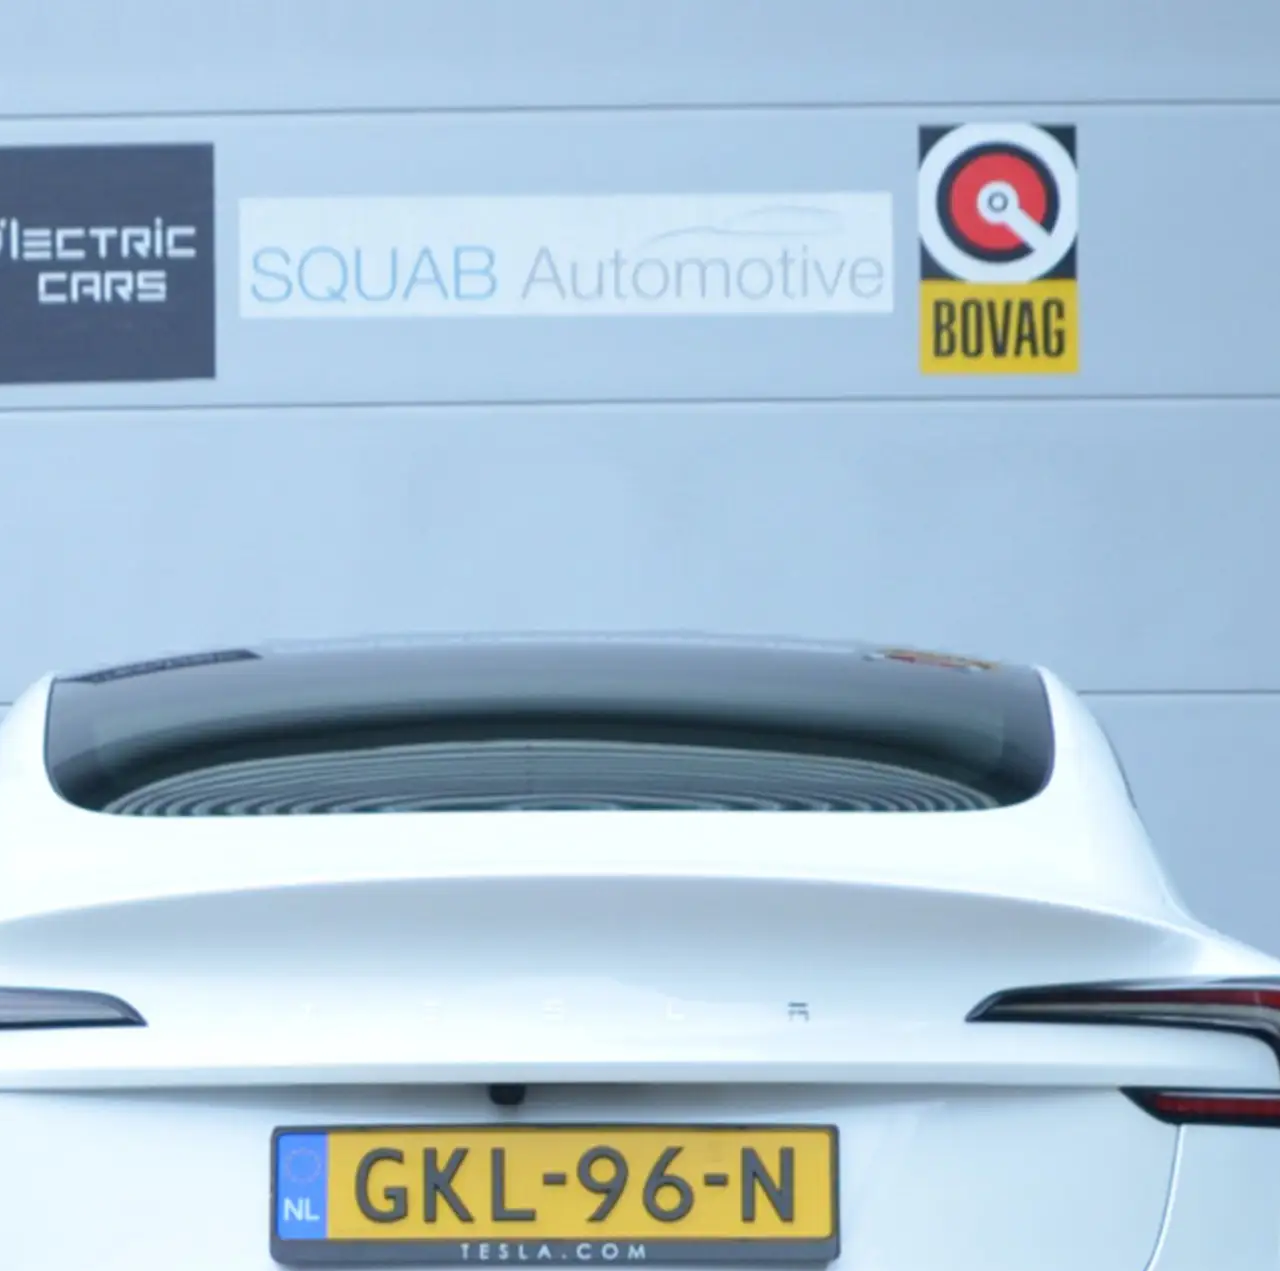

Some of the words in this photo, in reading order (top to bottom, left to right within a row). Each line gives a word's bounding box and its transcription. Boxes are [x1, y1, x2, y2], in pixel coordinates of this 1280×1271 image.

[38, 269, 167, 304] CARS
[250, 245, 498, 302] SQUAB
[521, 244, 886, 301] Automotive
[933, 297, 1066, 360] BOVAG
[353, 1144, 796, 1225] GKL-96-N
[283, 1196, 321, 1222] NL
[460, 1242, 647, 1261] TESLA.COM
